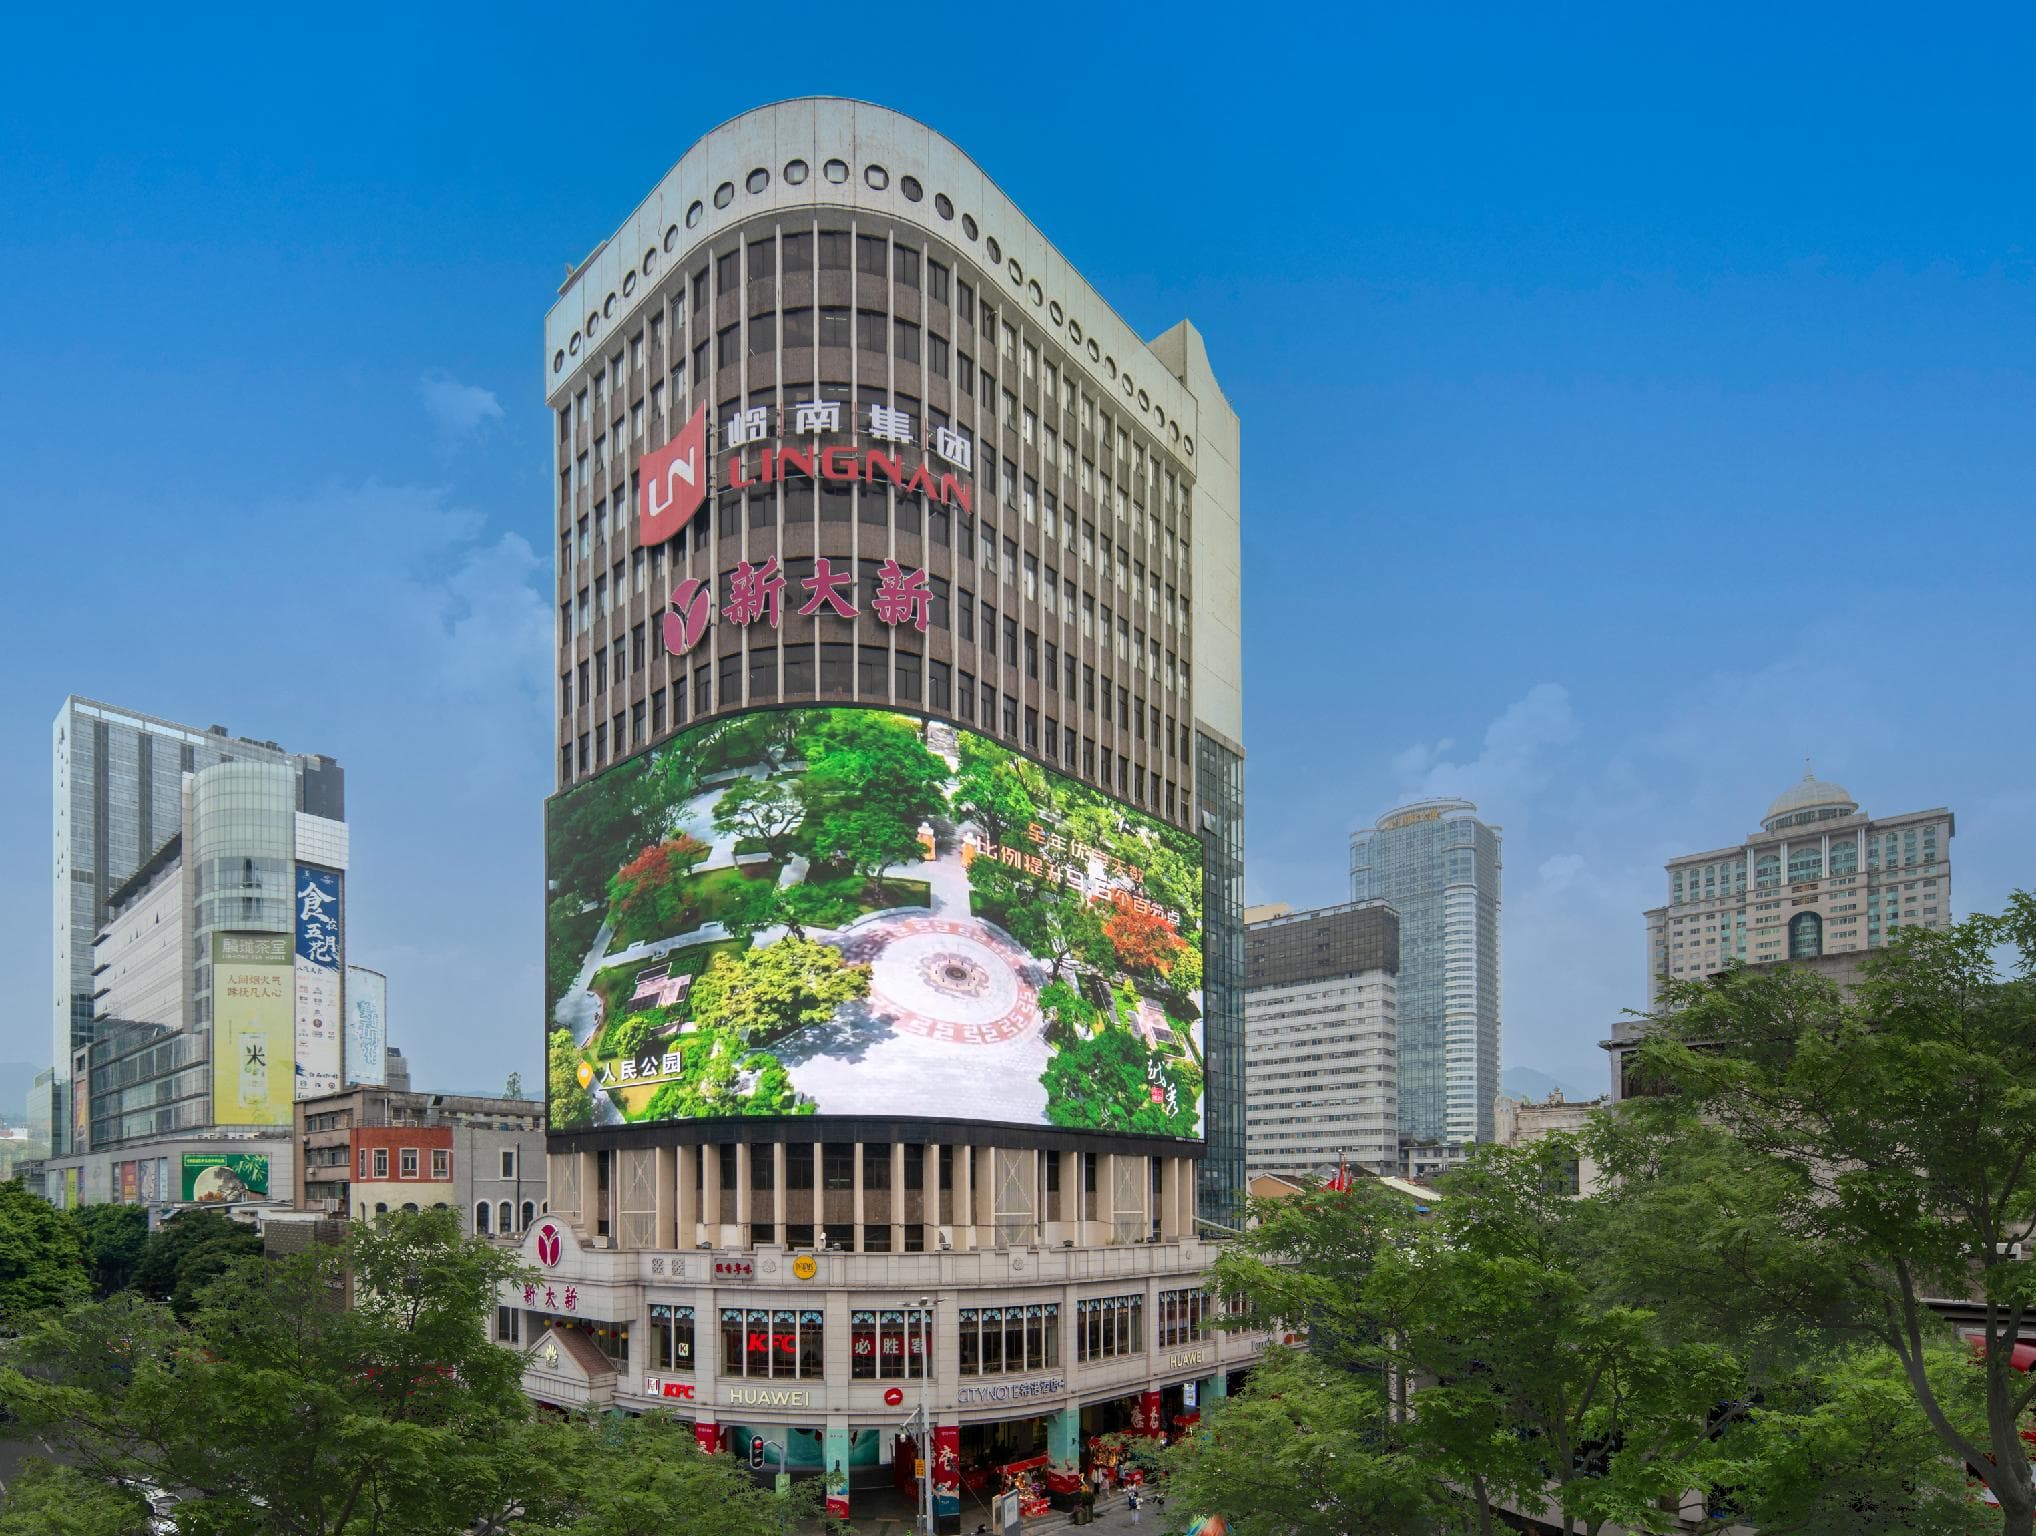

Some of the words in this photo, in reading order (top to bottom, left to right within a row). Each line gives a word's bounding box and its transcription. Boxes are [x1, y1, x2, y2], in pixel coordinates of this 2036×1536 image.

[728, 400, 971, 472] 岭南集团
[729, 446, 971, 514] LINGNAN
[721, 555, 934, 633] 新大新
[600, 1052, 681, 1084] 人民公园
[523, 1283, 577, 1310] 新大新
[747, 1333, 798, 1353] KFC
[1170, 1350, 1204, 1369] HUAWEI
[663, 1383, 695, 1399] KFC
[730, 1388, 810, 1406] HUAWEI
